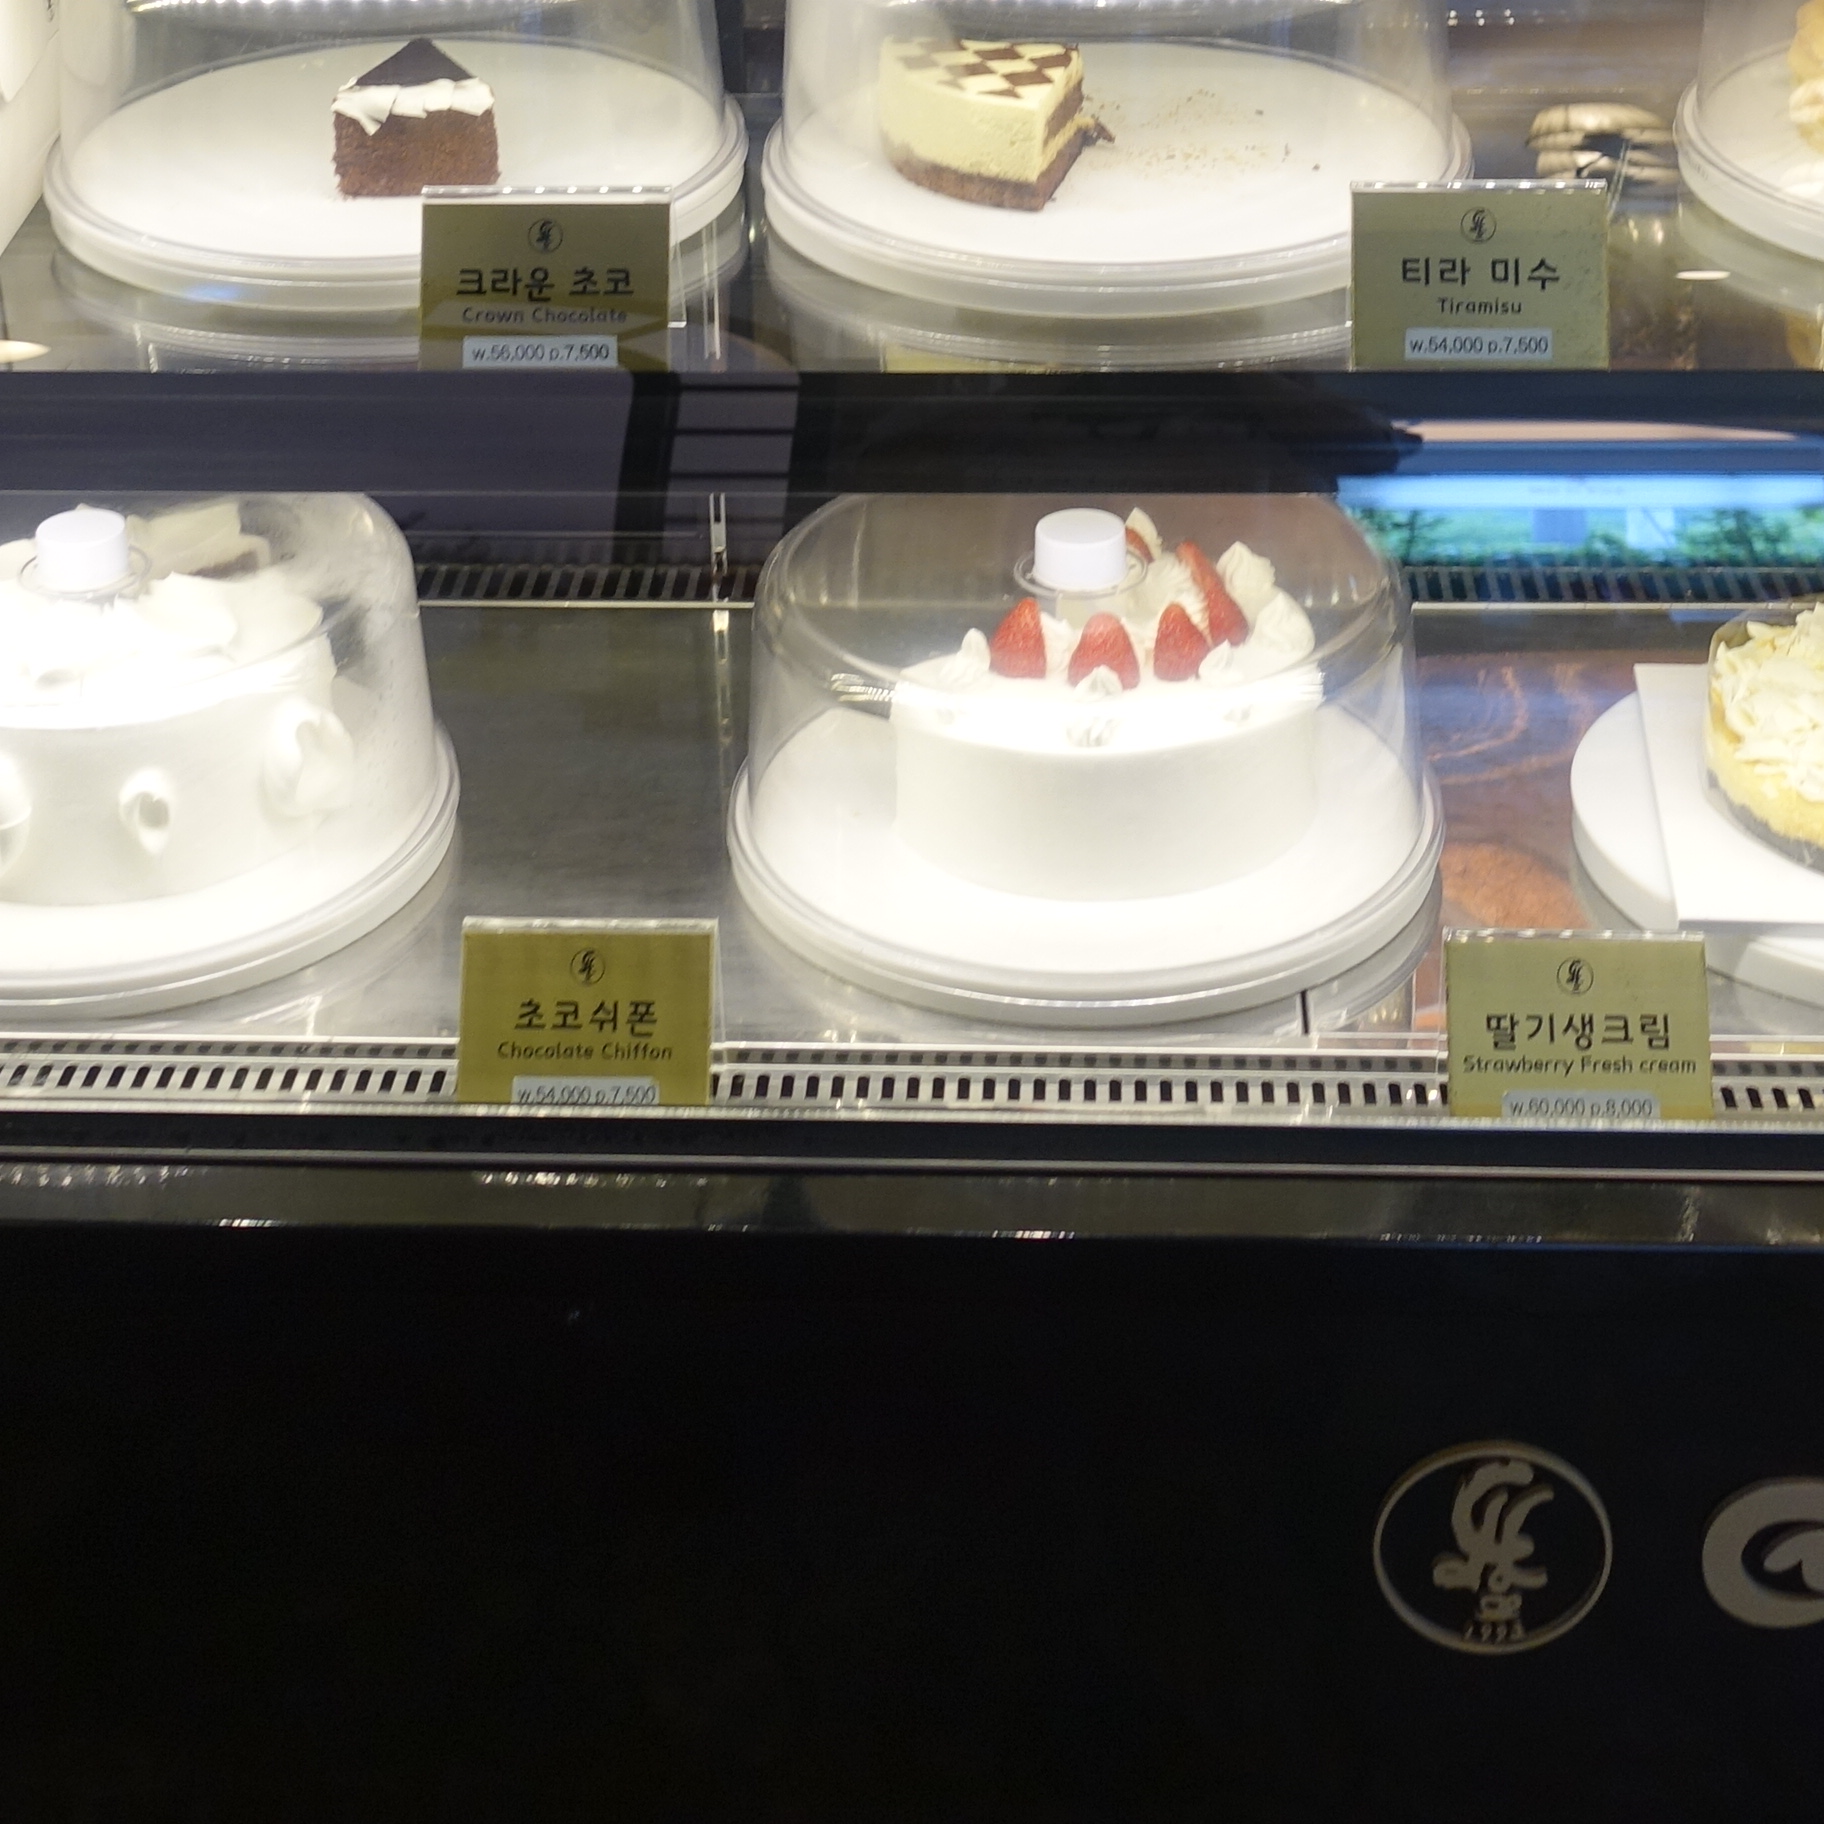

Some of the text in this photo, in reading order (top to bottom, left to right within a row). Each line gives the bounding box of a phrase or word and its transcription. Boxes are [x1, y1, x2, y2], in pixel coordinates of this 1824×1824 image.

[456, 267, 634, 302] 크라운 초코
[1402, 257, 1560, 291] 티라 미수
[462, 308, 627, 323] Crown Chocolate
[1438, 298, 1522, 315] Tiramisu
[514, 998, 658, 1038] 초코쉬폰
[1486, 1013, 1670, 1051] 딸기생크림
[497, 1042, 672, 1060] Chocolate Chiffon
[1463, 1055, 1696, 1077] Strawberry Fresh cream
